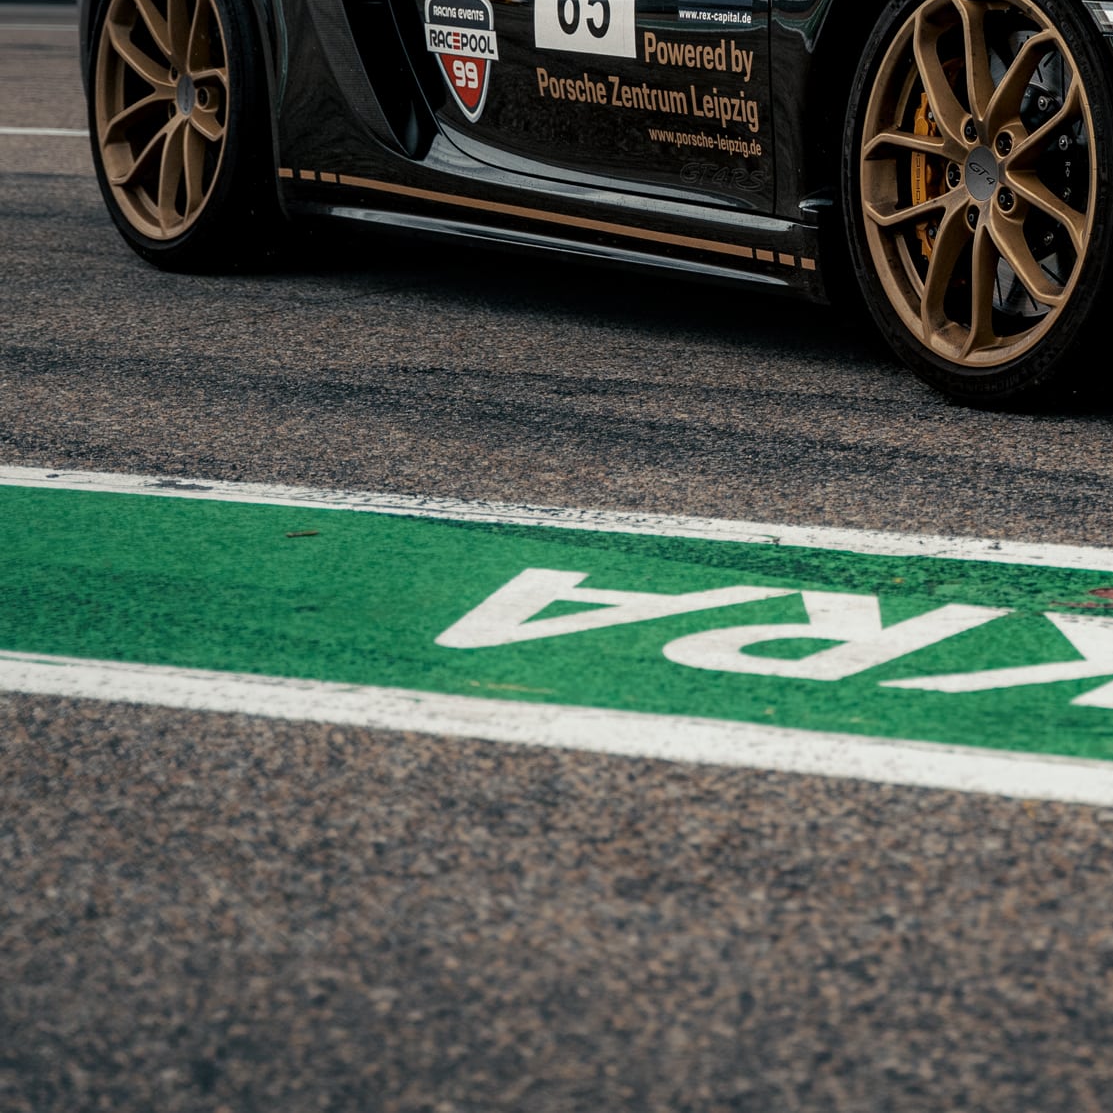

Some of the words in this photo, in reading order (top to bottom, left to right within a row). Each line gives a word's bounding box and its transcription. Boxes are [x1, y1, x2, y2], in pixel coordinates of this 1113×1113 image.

[678, 9, 752, 24] www.rex-capital.de
[429, 29, 495, 55] RACEPOOL
[643, 31, 727, 71] Powered
[730, 40, 754, 83] by
[452, 59, 479, 89] 99
[536, 67, 607, 105] Porsche
[608, 76, 688, 115] Zentrum
[690, 85, 759, 133] Leipzig
[648, 127, 762, 158] www.porsche-leipzig.de
